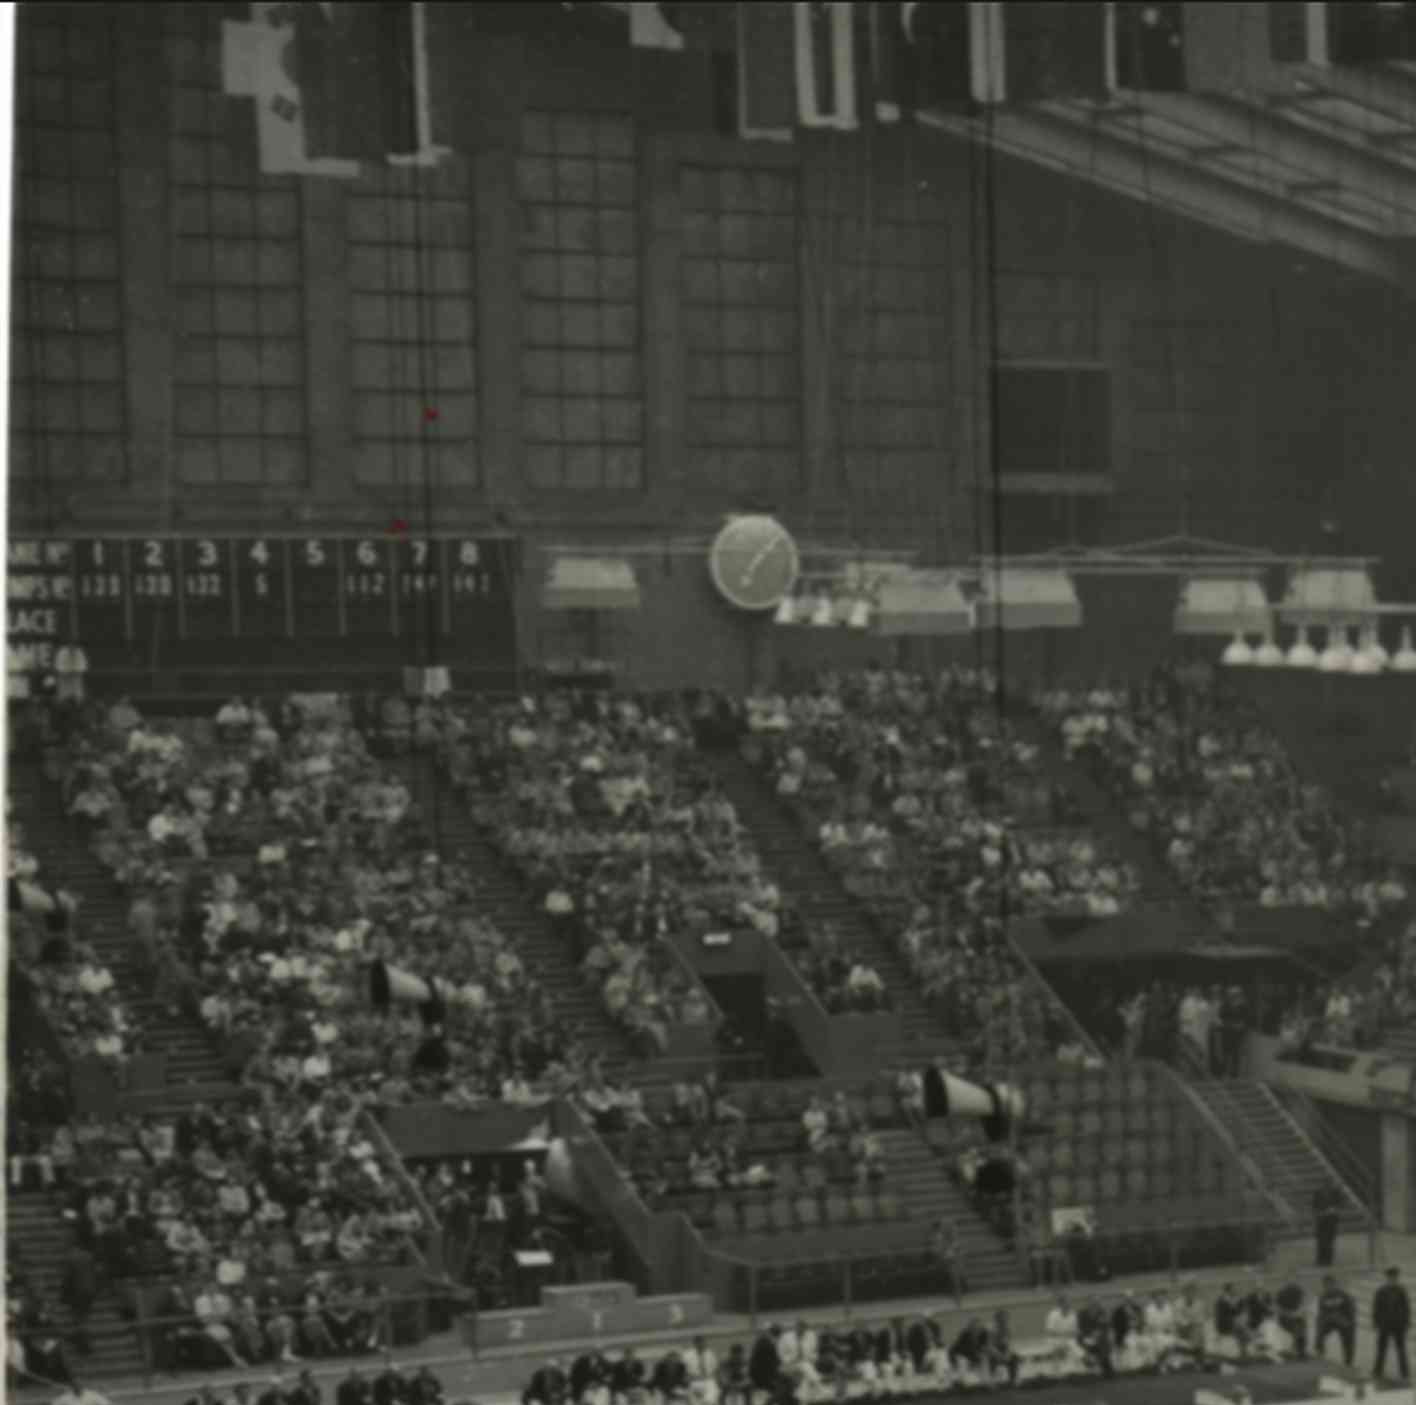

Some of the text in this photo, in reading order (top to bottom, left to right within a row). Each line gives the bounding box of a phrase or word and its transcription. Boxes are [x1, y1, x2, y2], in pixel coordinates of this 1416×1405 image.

[93, 540, 103, 566] 1
[145, 540, 165, 567] 2
[197, 540, 218, 567] 3
[249, 540, 270, 565] 4
[306, 540, 326, 567] 5
[357, 540, 377, 567] 6
[411, 540, 428, 566] 7
[460, 540, 480, 566] 8
